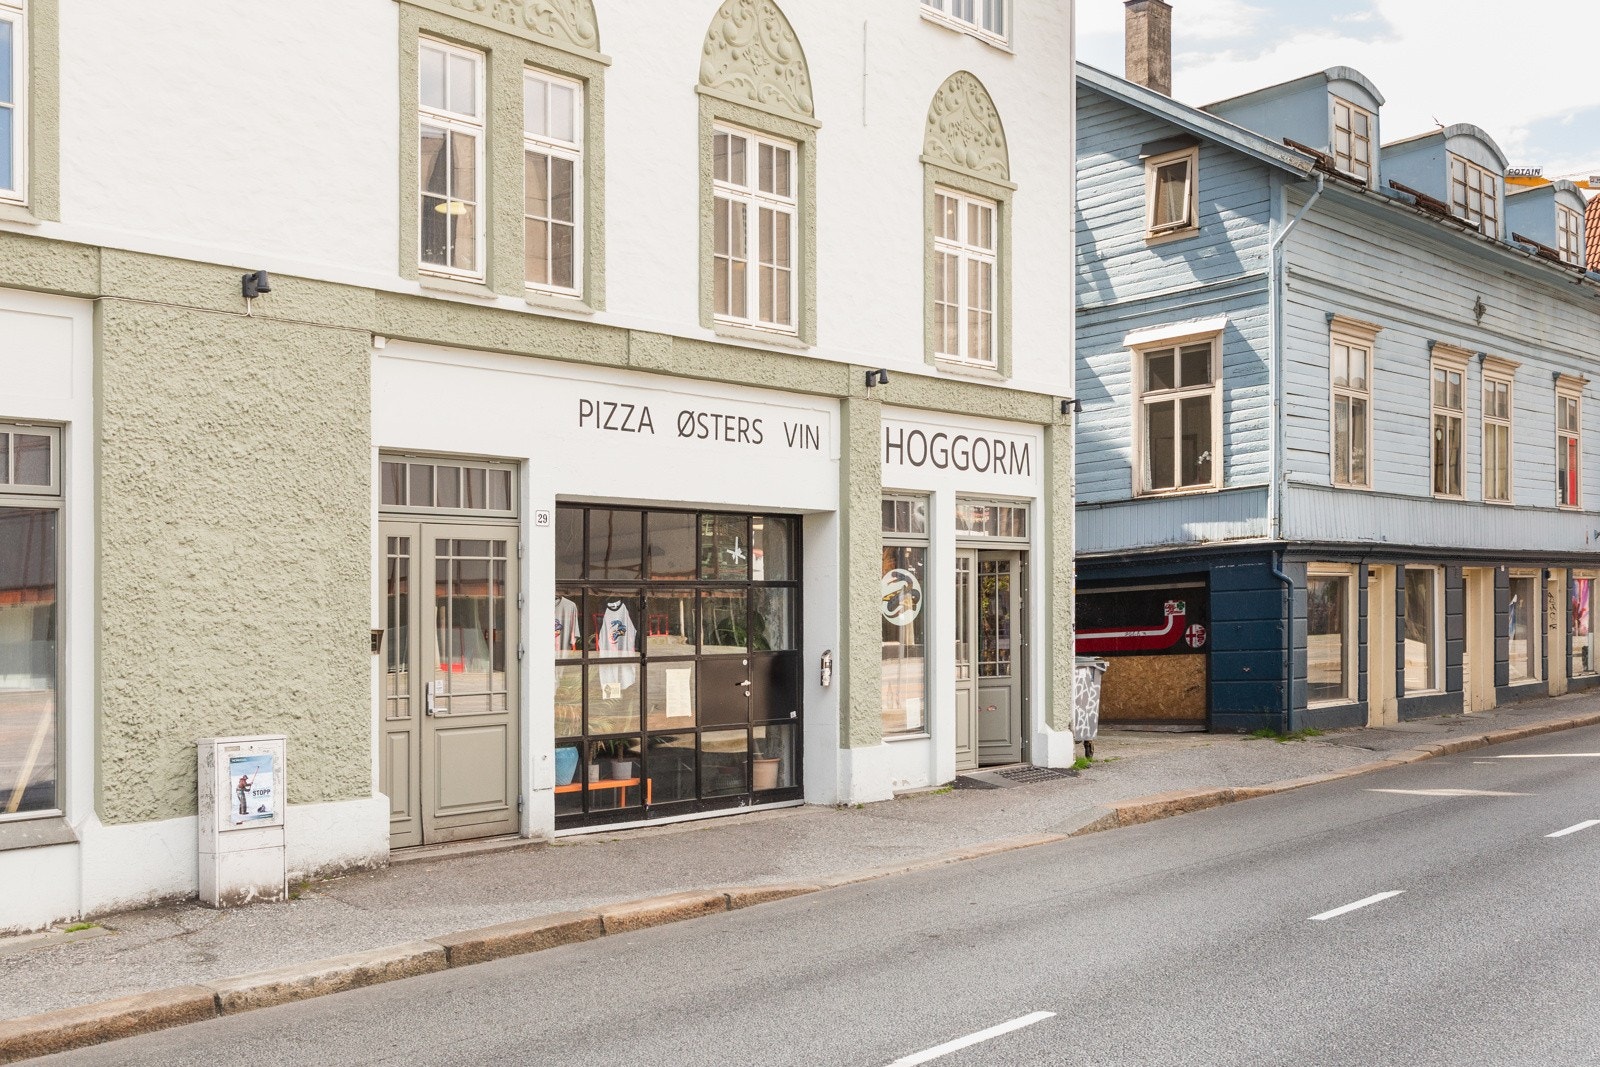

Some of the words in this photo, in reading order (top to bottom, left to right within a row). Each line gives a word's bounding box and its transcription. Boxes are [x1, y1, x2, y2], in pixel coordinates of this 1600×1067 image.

[1508, 168, 1541, 176] POTAIN
[579, 398, 655, 434] PIZZA
[677, 409, 764, 445] ØSTERS
[783, 421, 820, 451] VIN
[885, 426, 1031, 477] HOGGORM
[537, 513, 548, 524] 29
[252, 788, 271, 797] STOPP
